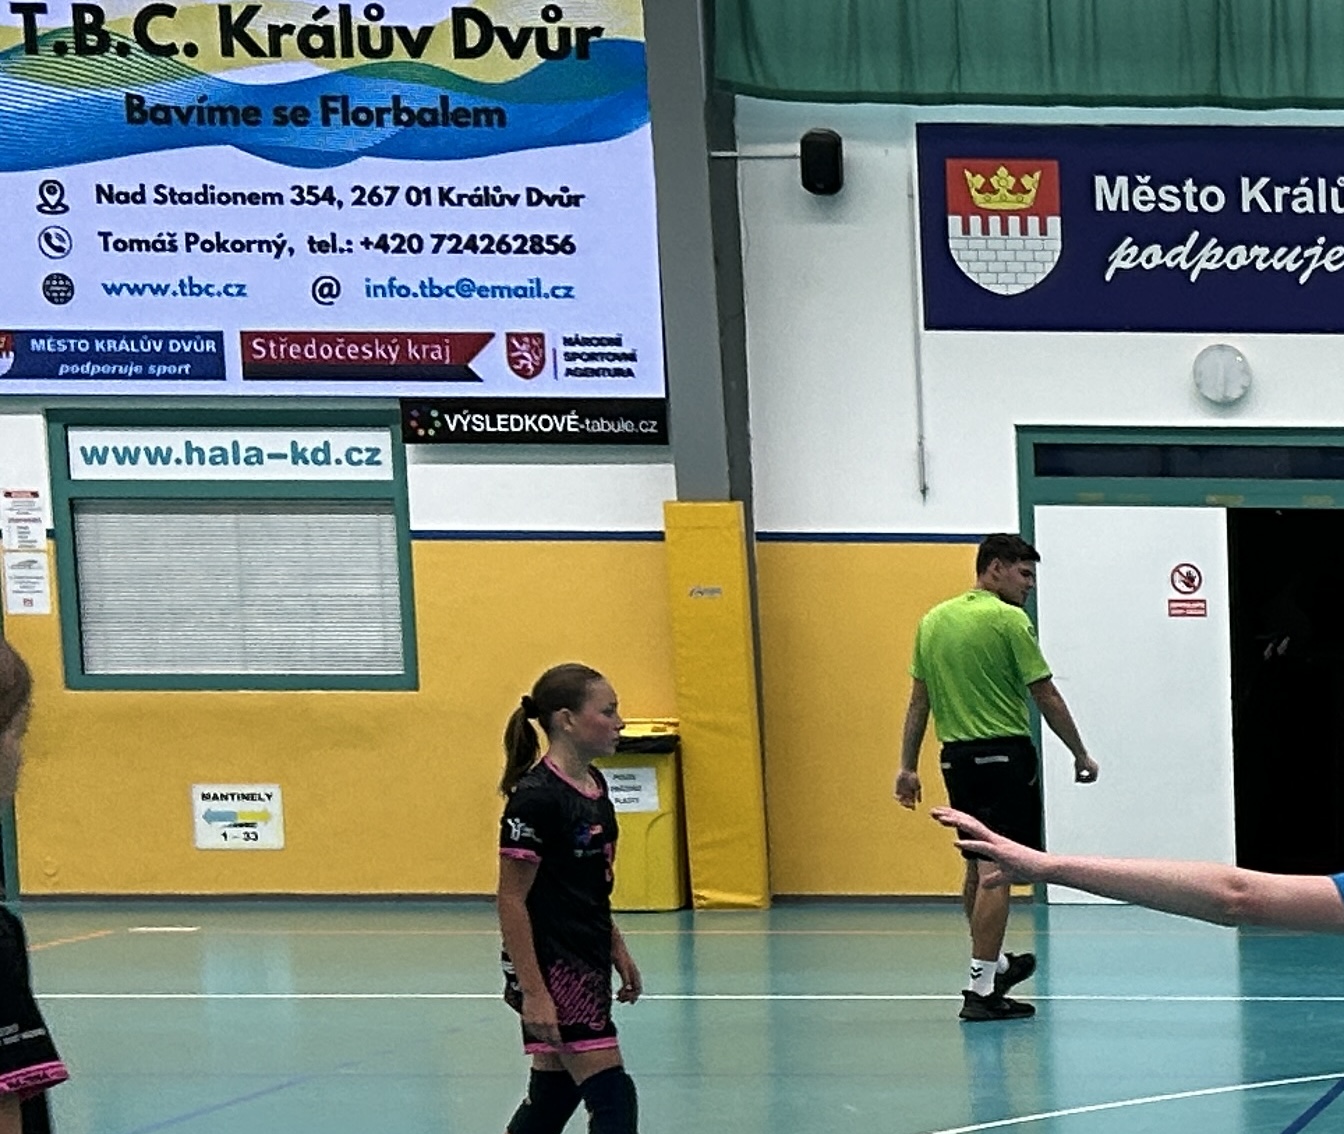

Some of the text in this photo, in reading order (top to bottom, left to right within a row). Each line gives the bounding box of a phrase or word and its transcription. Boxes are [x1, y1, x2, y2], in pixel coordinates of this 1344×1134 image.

[10, 3, 605, 60] T.B.C. Králův Dvůr
[125, 92, 507, 128] Bavíme se Florbalem
[95, 184, 586, 210] Nad Stadionem 354, 267 01 Králův Dvůr
[1095, 175, 1226, 213] Město
[98, 231, 577, 259] Tomáš Pokorný, tel.: +420 724262856
[101, 276, 248, 298] www.tbc.cz
[365, 277, 576, 300] info.tbc@email.cz
[30, 334, 217, 353] MĚSTO KRÁLŮV DVŮR
[252, 338, 450, 365] Středočeský kraj
[58, 360, 191, 377] podporuje sport
[444, 410, 658, 434] VÝSLEDKOVÉ-tabule.cz
[79, 439, 383, 467] www.hala-kd.cz
[201, 791, 273, 802] MANTINELY
[221, 830, 228, 841] 1
[242, 830, 259, 842] 33
